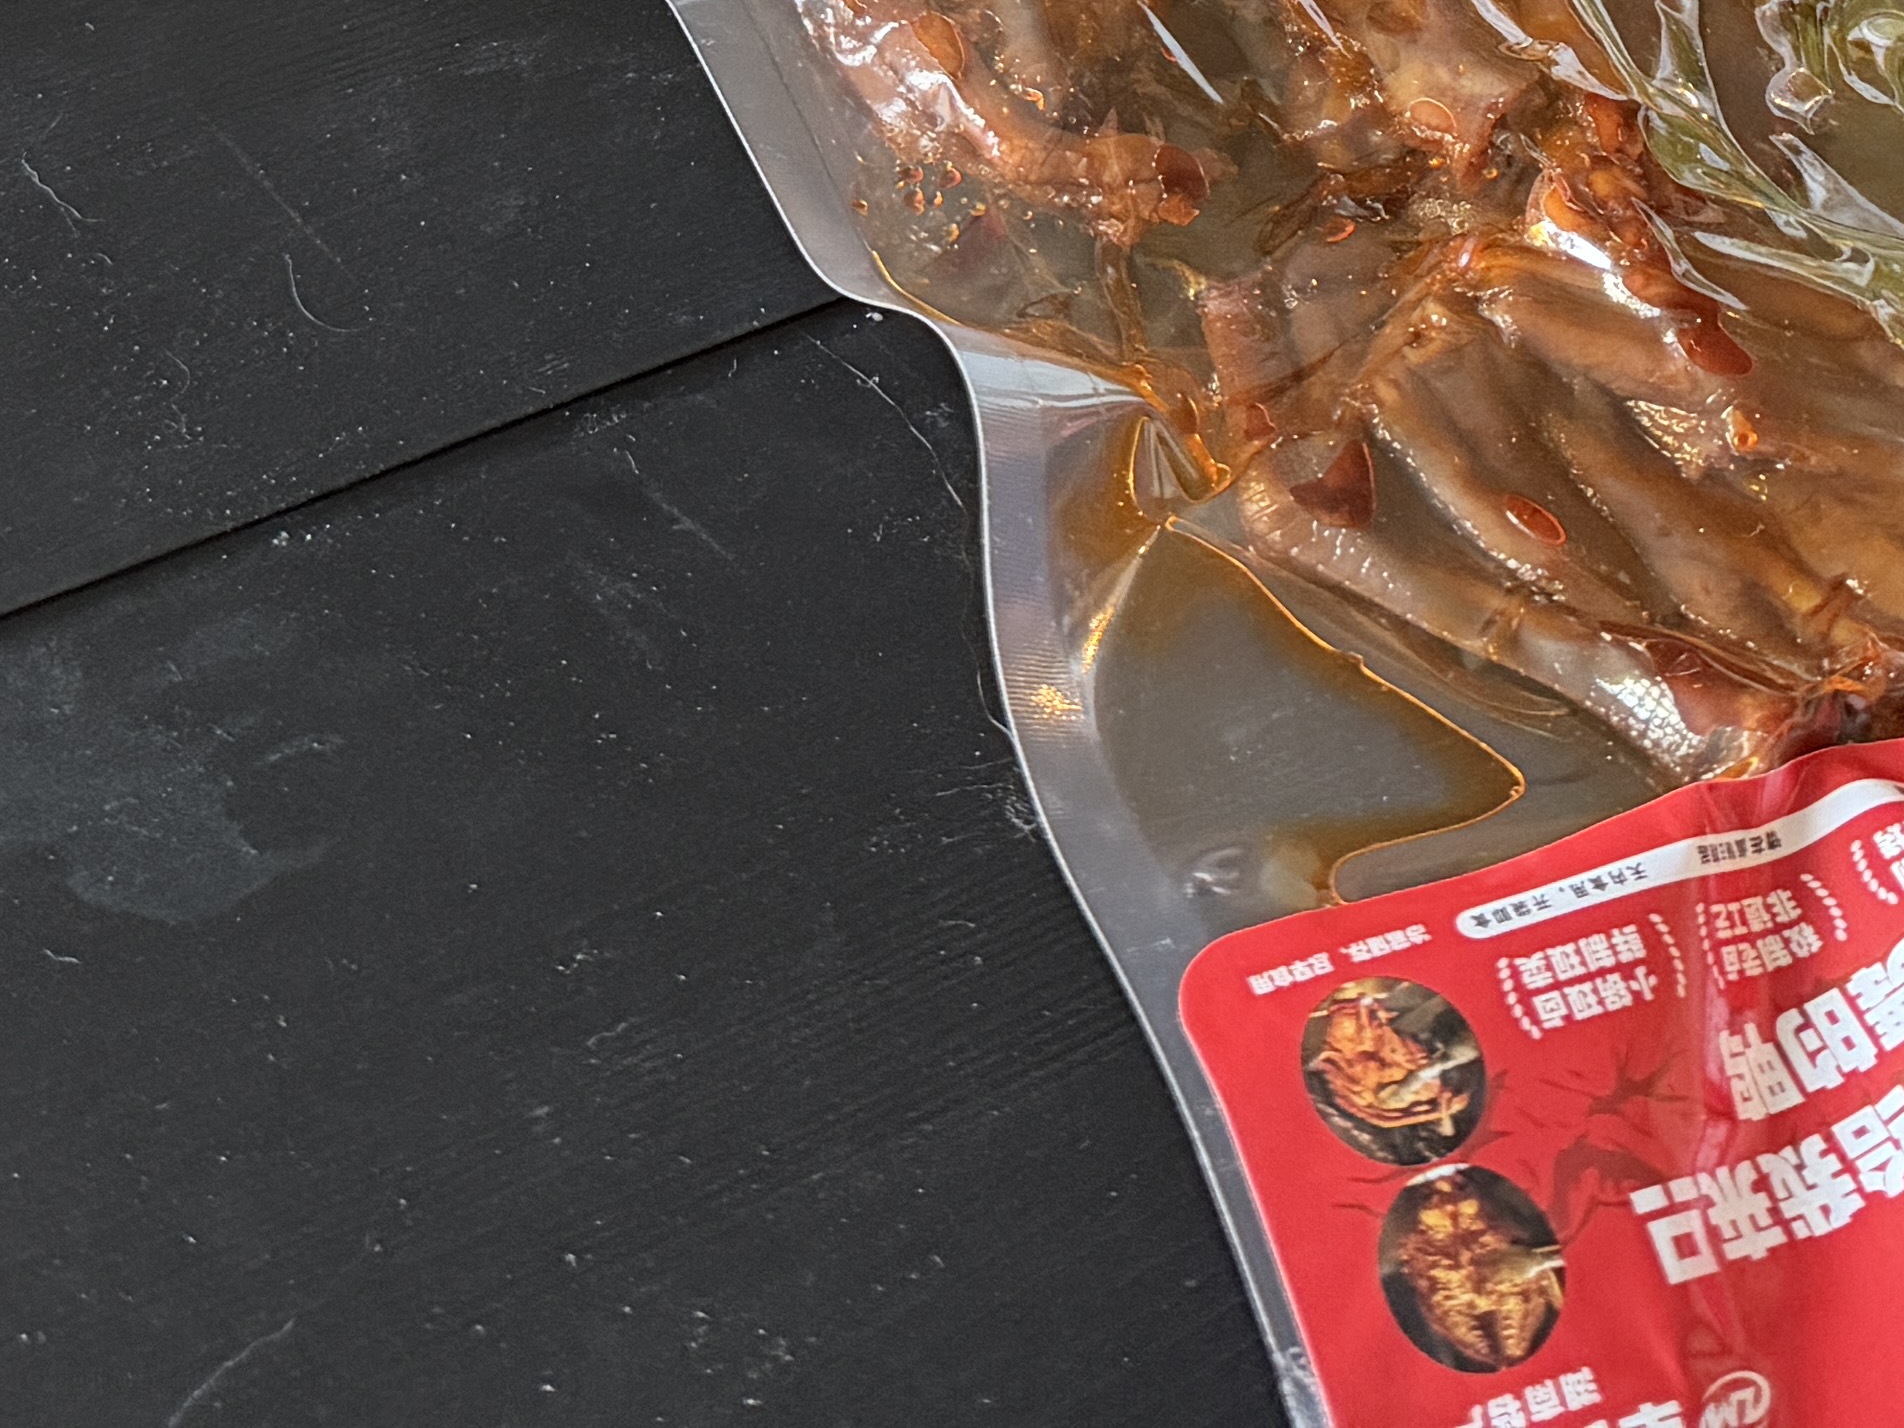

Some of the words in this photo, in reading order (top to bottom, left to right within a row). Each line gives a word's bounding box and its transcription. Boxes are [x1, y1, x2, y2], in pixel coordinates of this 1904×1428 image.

[1709, 888, 1802, 939] 非遗工艺
[1514, 924, 1648, 991] 鲜制现卖
[1532, 965, 1660, 1031] 小锅现卤
